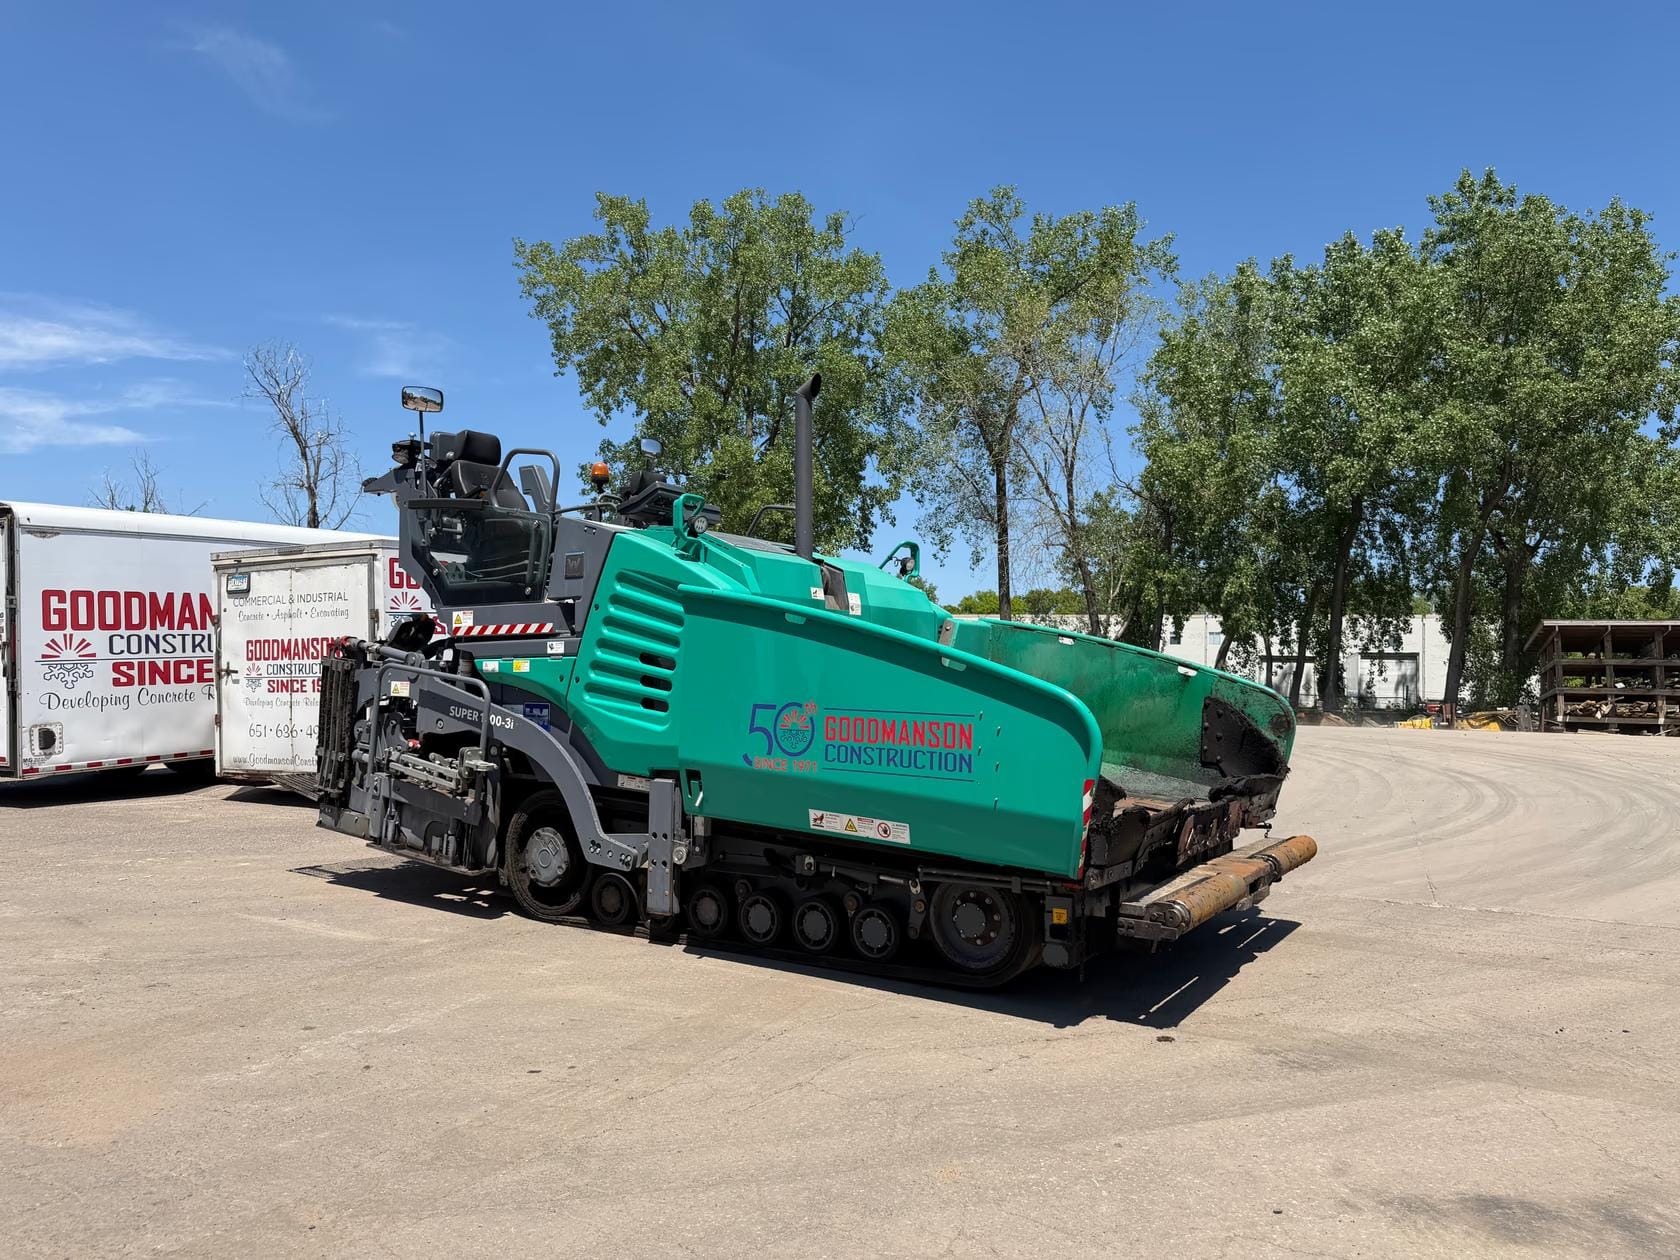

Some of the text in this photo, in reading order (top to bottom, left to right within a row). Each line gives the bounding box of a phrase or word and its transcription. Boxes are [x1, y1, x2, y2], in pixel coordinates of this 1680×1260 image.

[233, 592, 349, 607] COMMERCIAL & INDUSTRIAL
[238, 607, 349, 622] Concrete Asphalt Excavating
[112, 659, 214, 687] SINCE
[267, 679, 307, 693] SINCE
[39, 691, 130, 712] Developing
[137, 687, 196, 706] Concrete
[449, 706, 479, 721] SUPER
[824, 715, 973, 750] GOODMANSON
[753, 756, 817, 773] SINCE 1971
[824, 743, 973, 774] CONSTRUCTION
